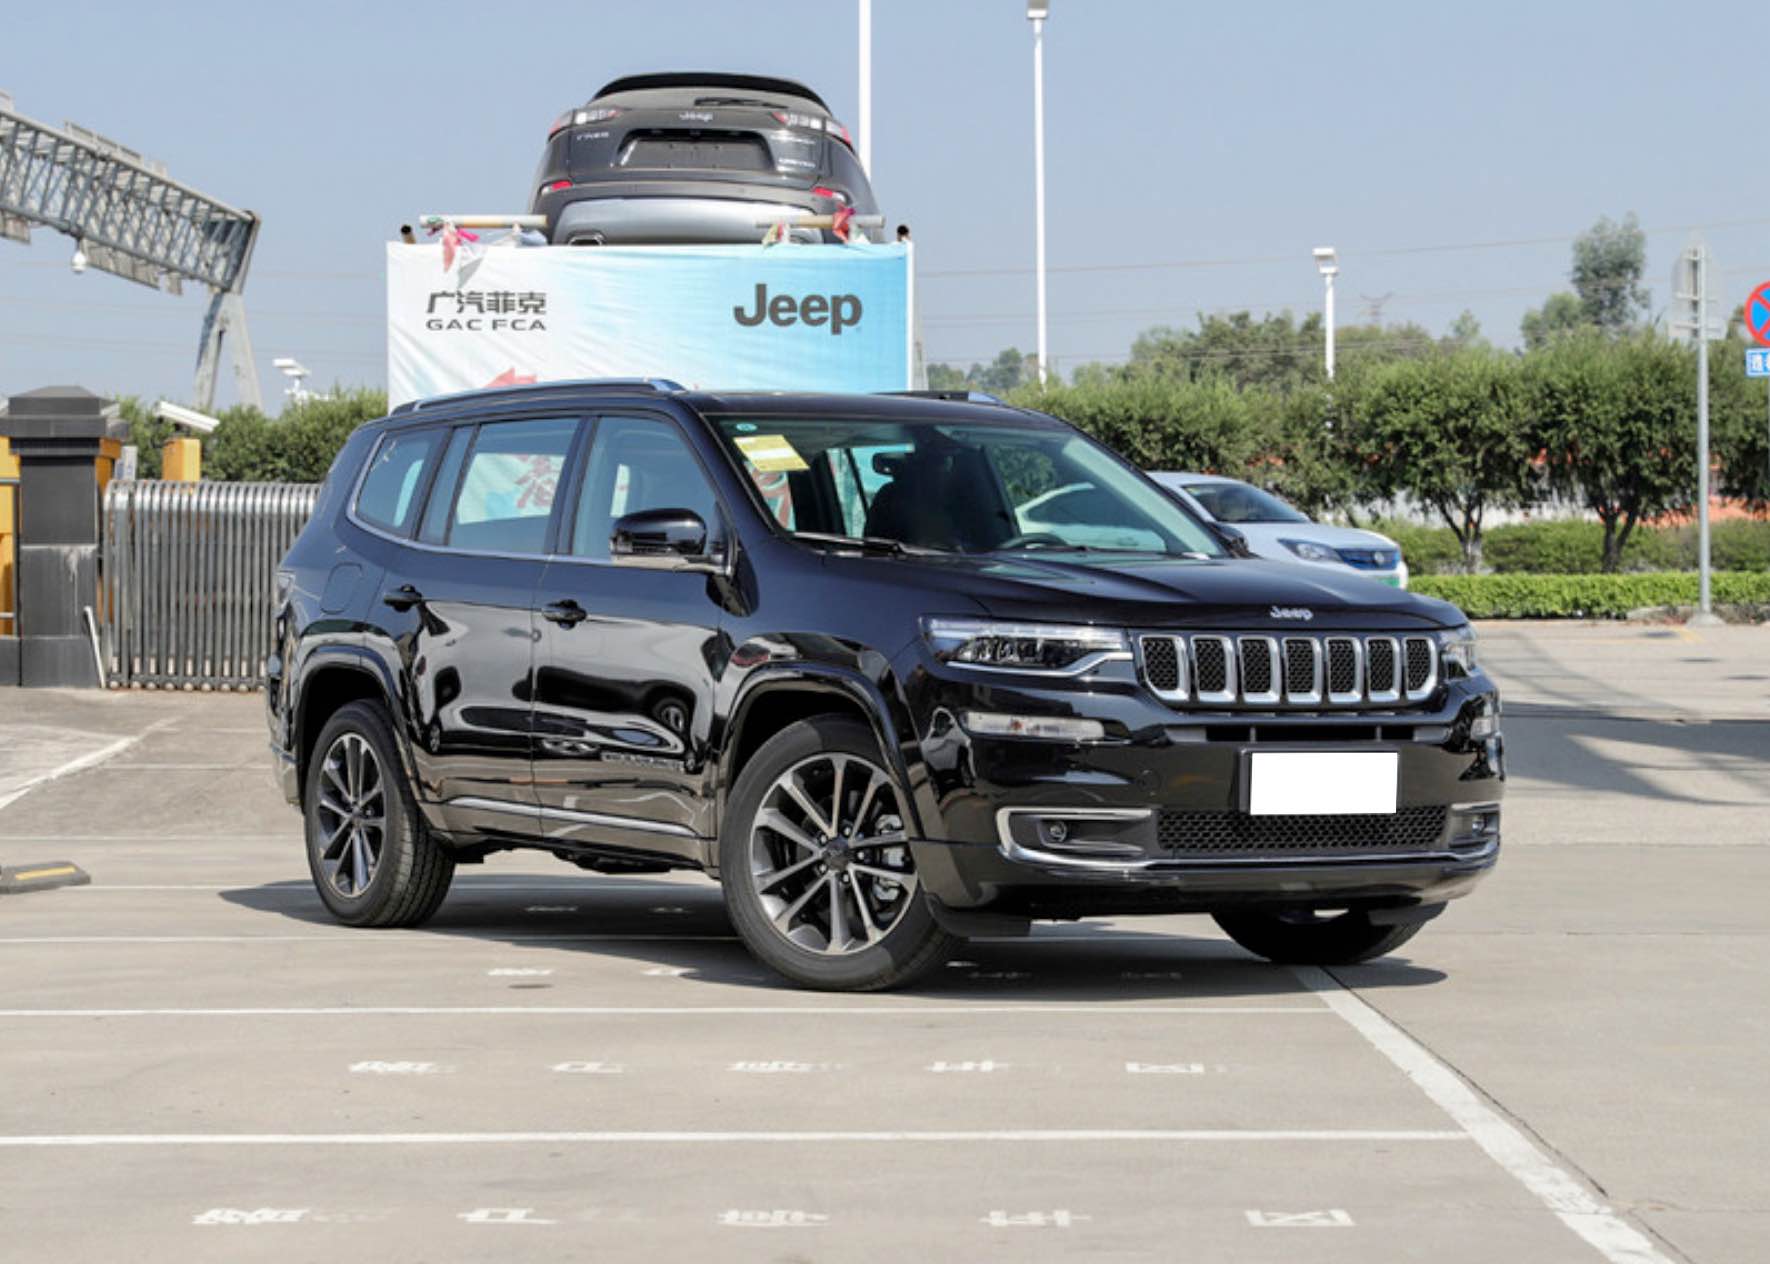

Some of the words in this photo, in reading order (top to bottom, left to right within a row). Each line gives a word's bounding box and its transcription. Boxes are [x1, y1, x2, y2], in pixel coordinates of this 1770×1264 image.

[426, 290, 547, 315] 广汽菲克
[733, 283, 863, 335] Jeep
[426, 319, 483, 331] GAC
[492, 319, 547, 331] FCA
[1270, 606, 1314, 621] Jeep
